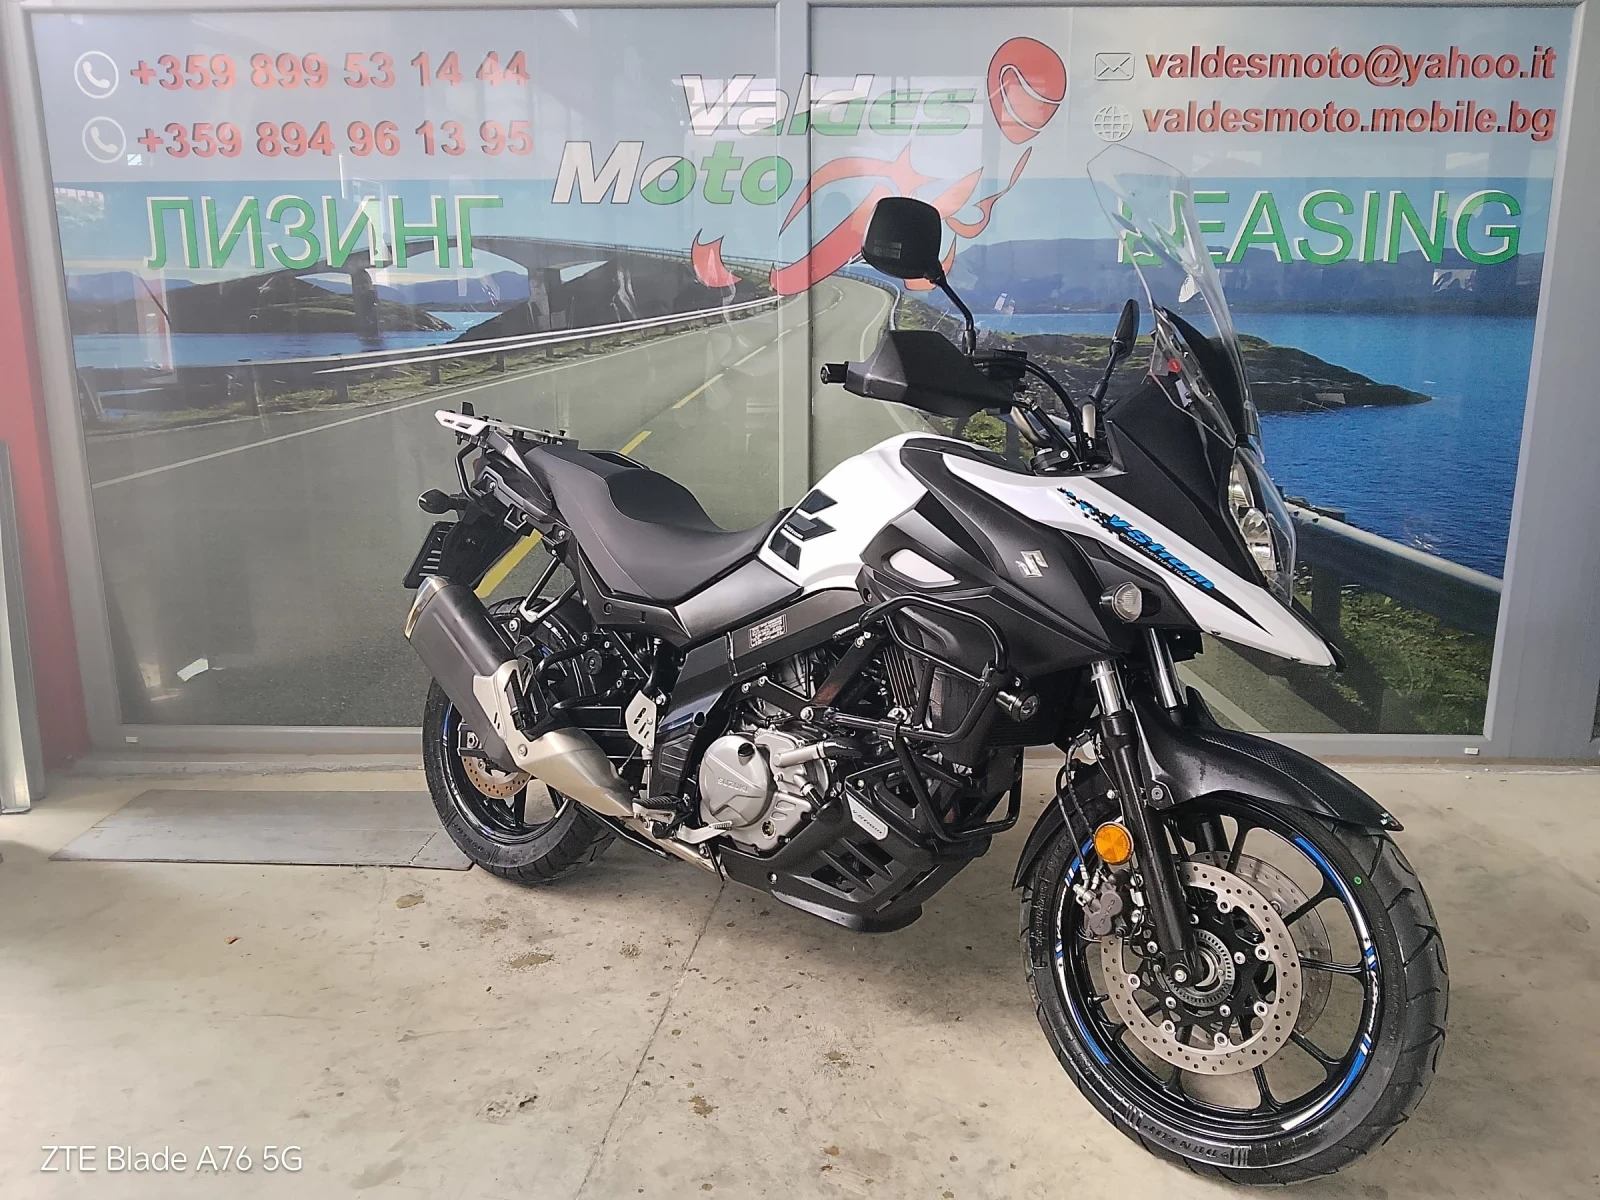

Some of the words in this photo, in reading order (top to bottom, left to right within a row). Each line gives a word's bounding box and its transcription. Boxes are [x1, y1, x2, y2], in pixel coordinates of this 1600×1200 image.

[130, 53, 234, 90] +359
[250, 52, 329, 89] 899
[343, 52, 396, 89] 53
[411, 50, 463, 87] 14
[476, 50, 531, 86] 44
[1145, 43, 1557, 87] valdesmoto@yahoo.it
[681, 73, 977, 136] Valdes
[1143, 100, 1556, 141] valdesmoto.mobile.bg
[137, 121, 242, 158] +359
[256, 120, 335, 157] 894
[349, 120, 400, 157] 96
[415, 120, 466, 156] 13
[480, 120, 534, 156] 95
[551, 141, 793, 204] Moto
[143, 194, 503, 270] ЛИЗИНГ
[1120, 532, 1140, 548] SPORT
[1140, 545, 1173, 572] ADVENTURE
[1173, 567, 1198, 585] TOURER
